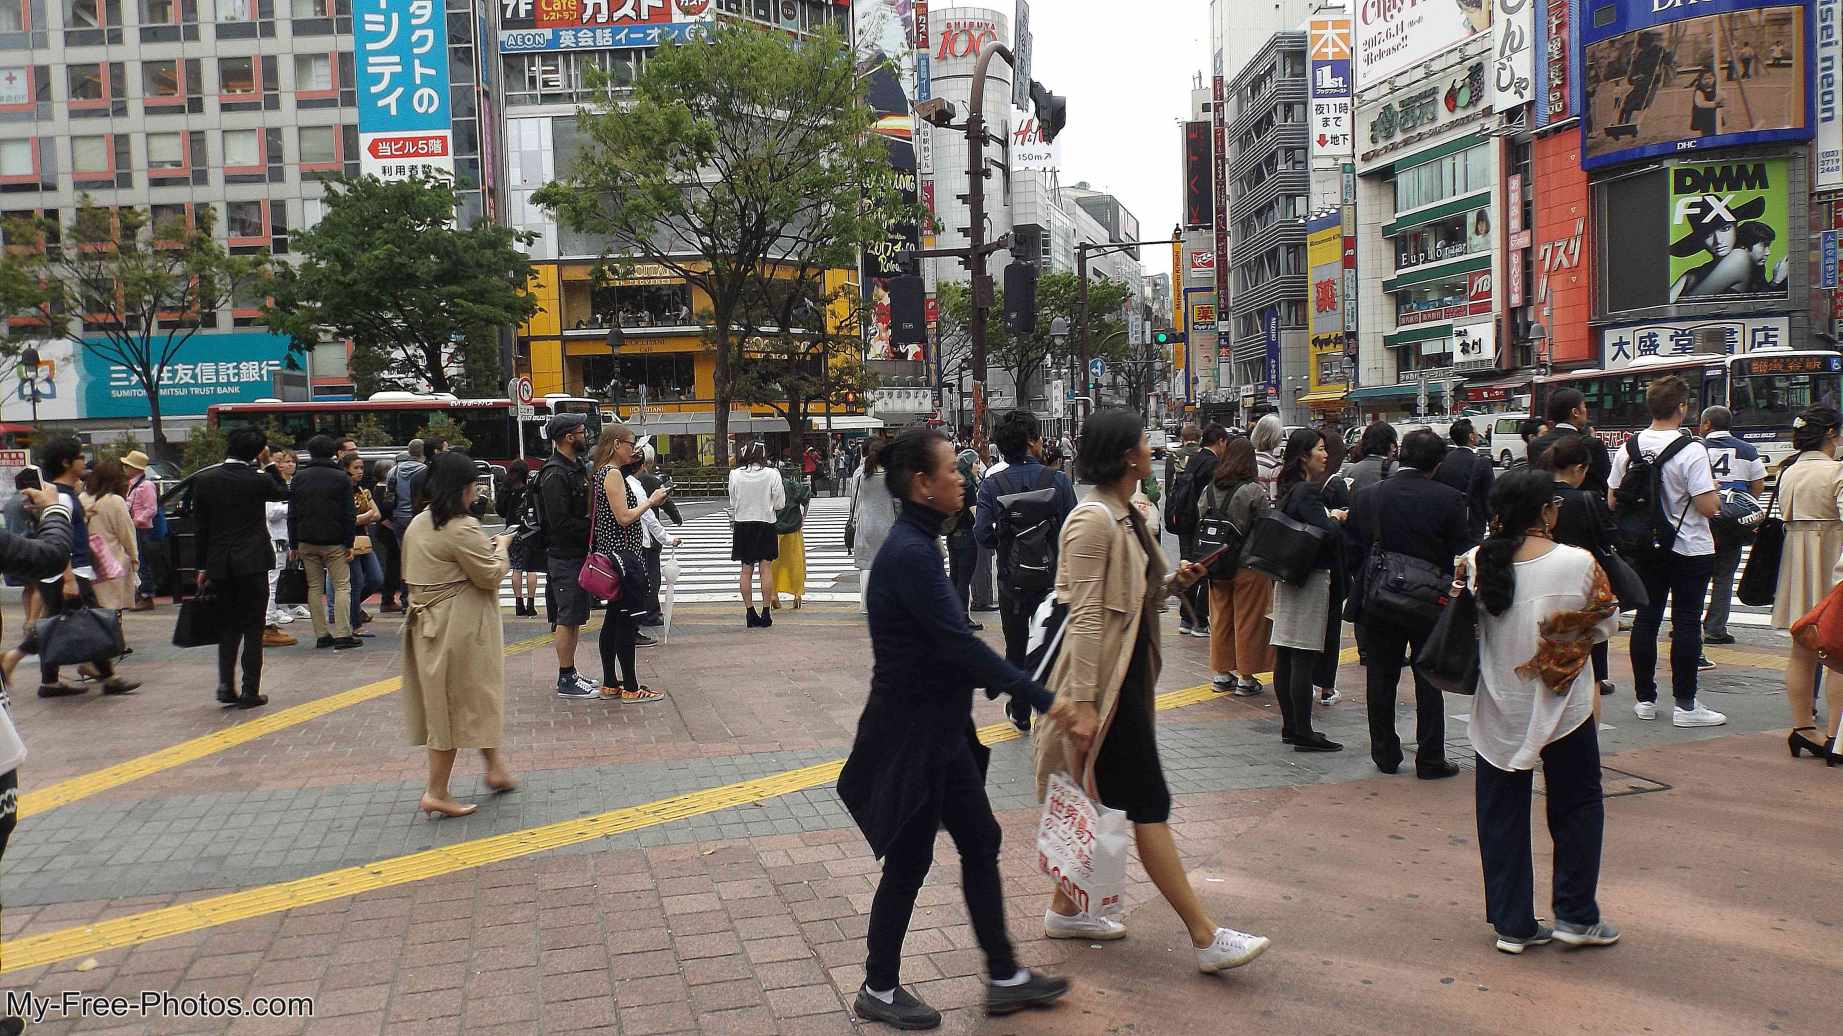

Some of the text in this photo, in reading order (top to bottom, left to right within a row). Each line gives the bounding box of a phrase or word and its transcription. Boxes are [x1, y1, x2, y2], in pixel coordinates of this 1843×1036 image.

[506, 33, 546, 49] AEON
[1314, 103, 1349, 116] 夜11時
[1321, 116, 1342, 128] まで
[1330, 134, 1350, 146] 地下
[1676, 141, 1697, 150] DHC
[377, 139, 443, 157] 当ビル5階
[1017, 152, 1042, 161] 150m
[1674, 163, 1770, 194] DMM
[1673, 194, 1737, 225] FX
[1470, 274, 1491, 298] JTB
[112, 386, 240, 397] SUMITO MITSUI TRUST BANK
